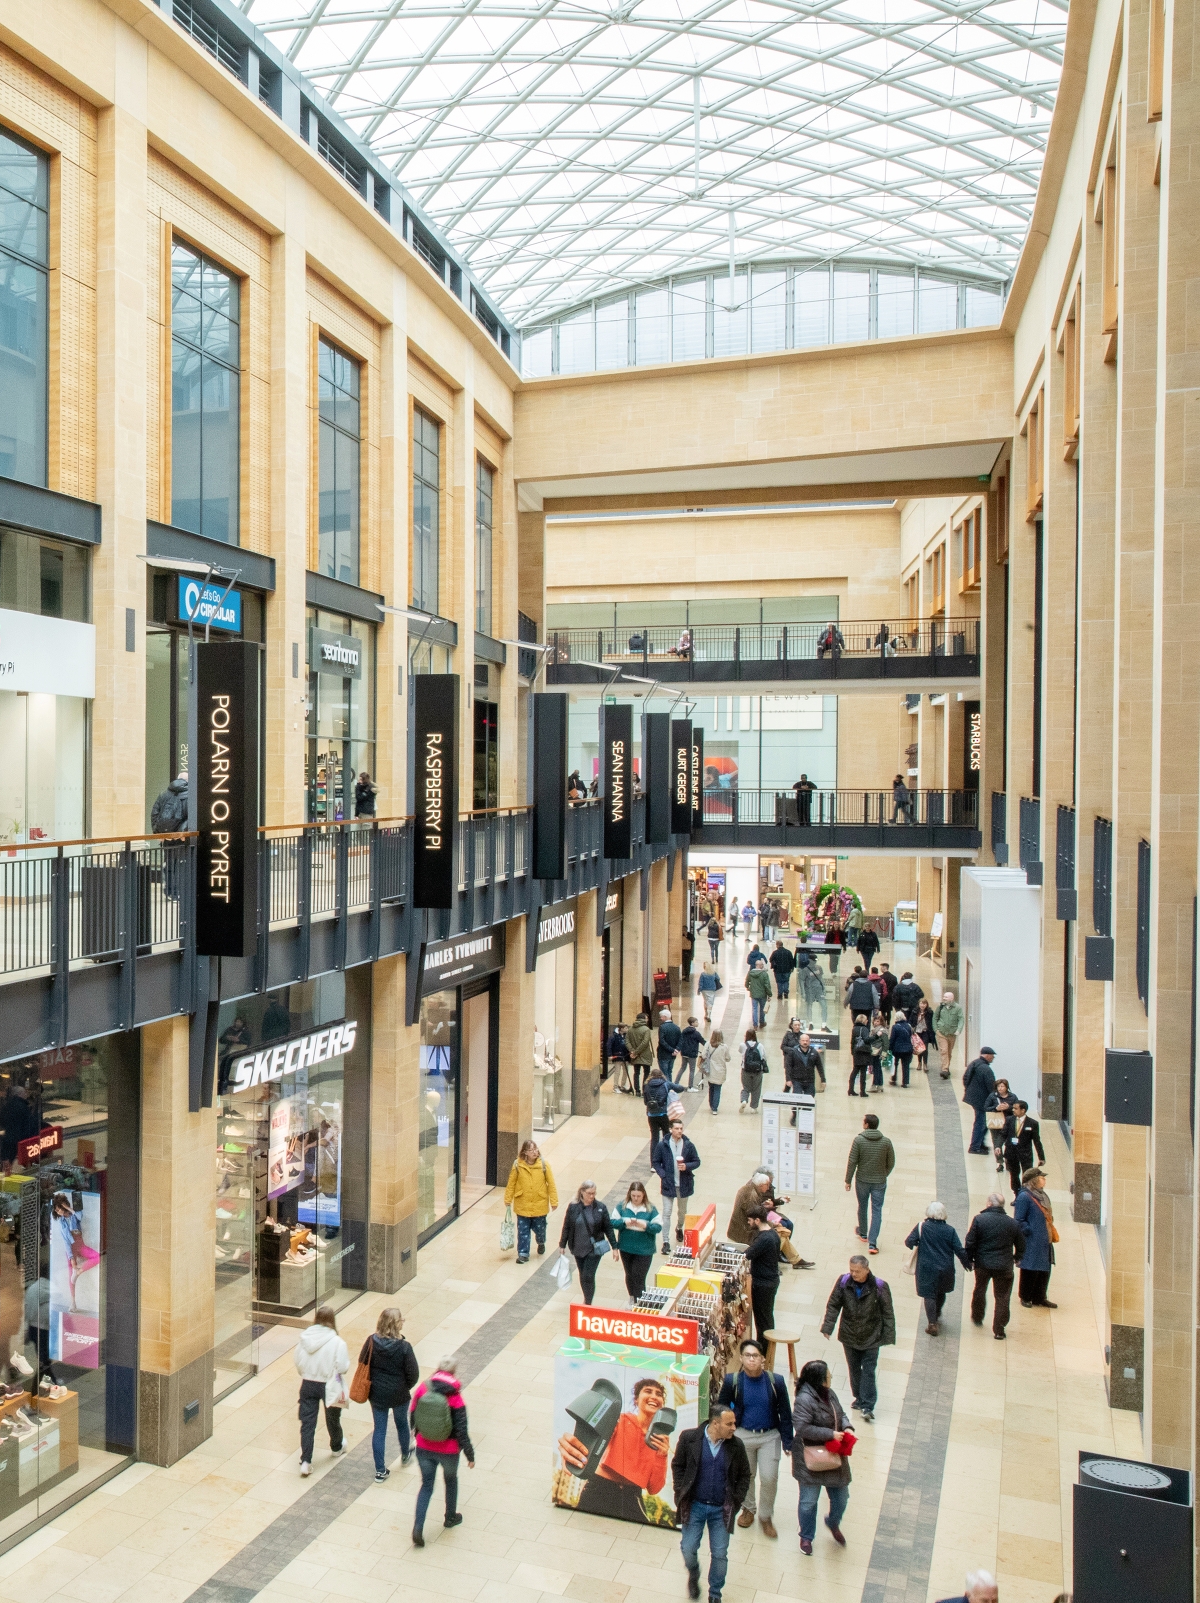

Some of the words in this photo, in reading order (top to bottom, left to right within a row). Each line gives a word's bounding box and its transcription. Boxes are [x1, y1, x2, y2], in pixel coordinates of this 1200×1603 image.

[212, 590, 221, 603] Go
[8, 661, 15, 674] Pi
[211, 695, 230, 793] POLARN
[612, 740, 624, 772] SEAN
[970, 713, 981, 770] STARBUCKS
[677, 748, 687, 771] KURT
[425, 733, 442, 832] RASPBERRY
[677, 773, 687, 805] GEIGER
[211, 800, 230, 823] O.
[611, 775, 623, 823] HANNA
[691, 795, 699, 811] ART
[425, 836, 441, 849] PI
[211, 832, 230, 903] PYRET
[538, 911, 575, 943] VERBROOKS
[424, 947, 453, 970] HARLES
[233, 1021, 357, 1093] SKECHERS
[577, 1311, 686, 1345] havaianas
